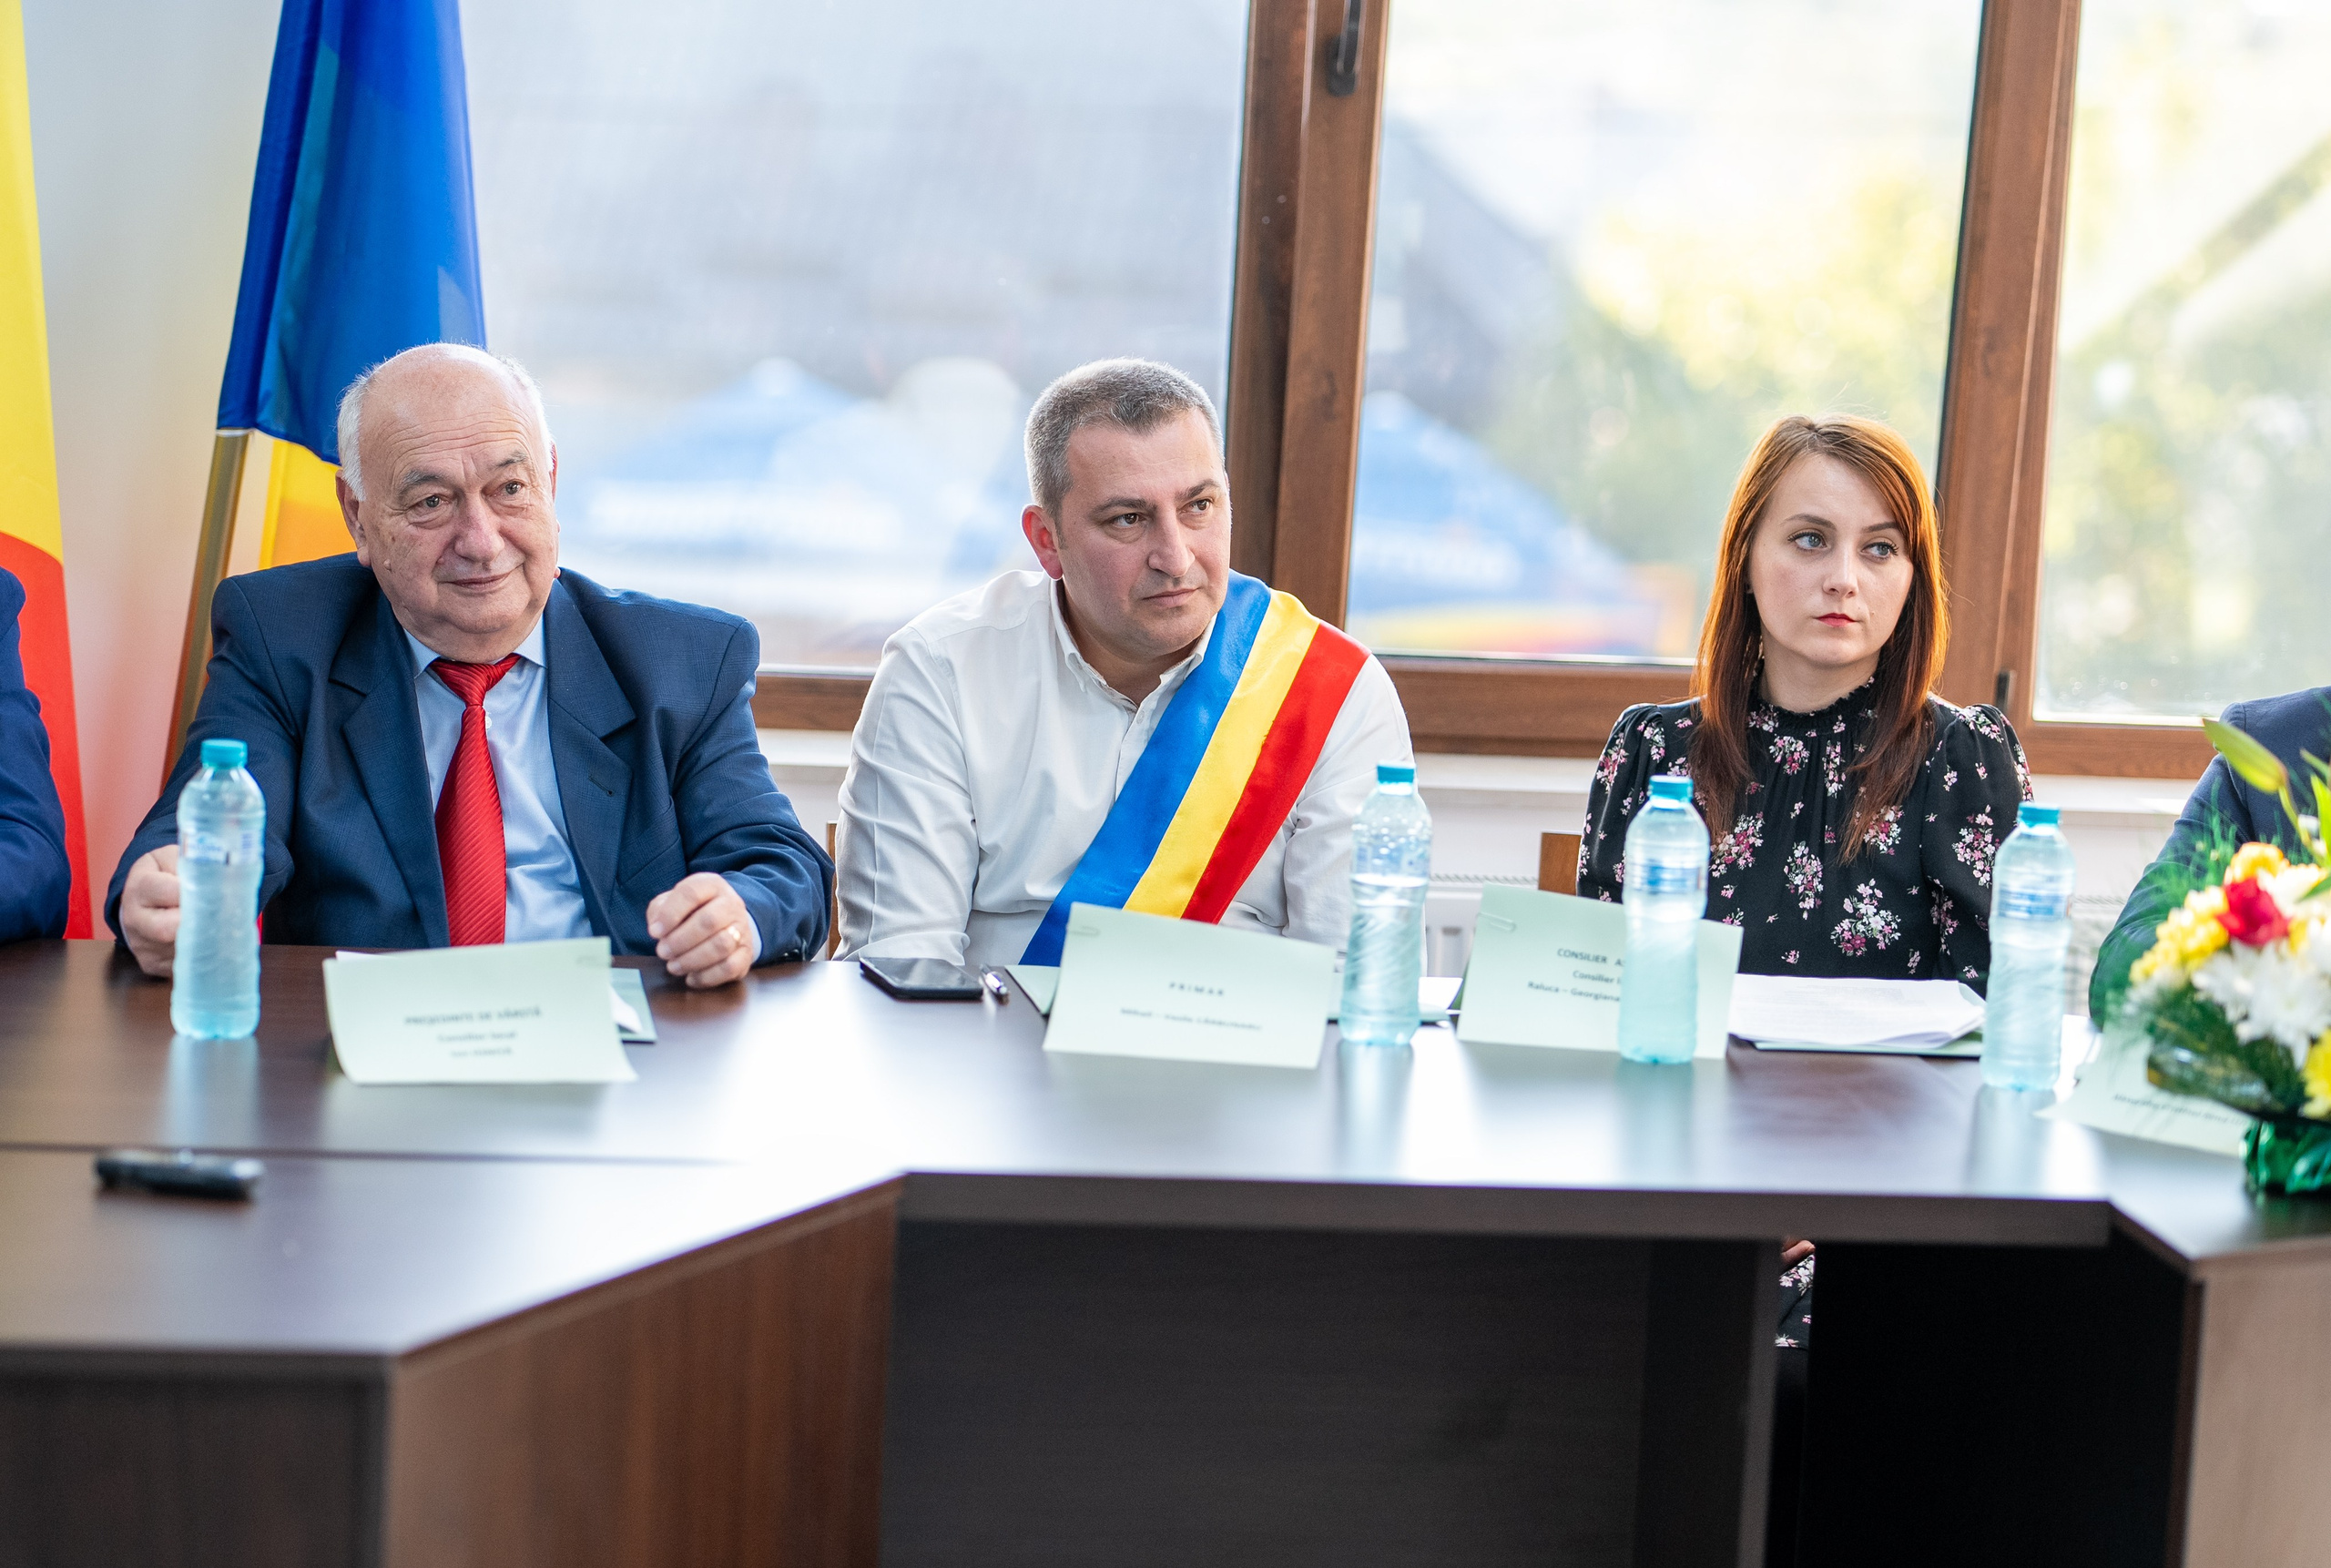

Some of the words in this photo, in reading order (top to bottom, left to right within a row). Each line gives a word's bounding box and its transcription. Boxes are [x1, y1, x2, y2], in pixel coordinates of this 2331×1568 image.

[1557, 948, 1607, 963] CONSILIER
[1573, 970, 1614, 983] Consilier
[1528, 981, 1559, 993] Raluca
[1571, 988, 1621, 1002] Georgiana
